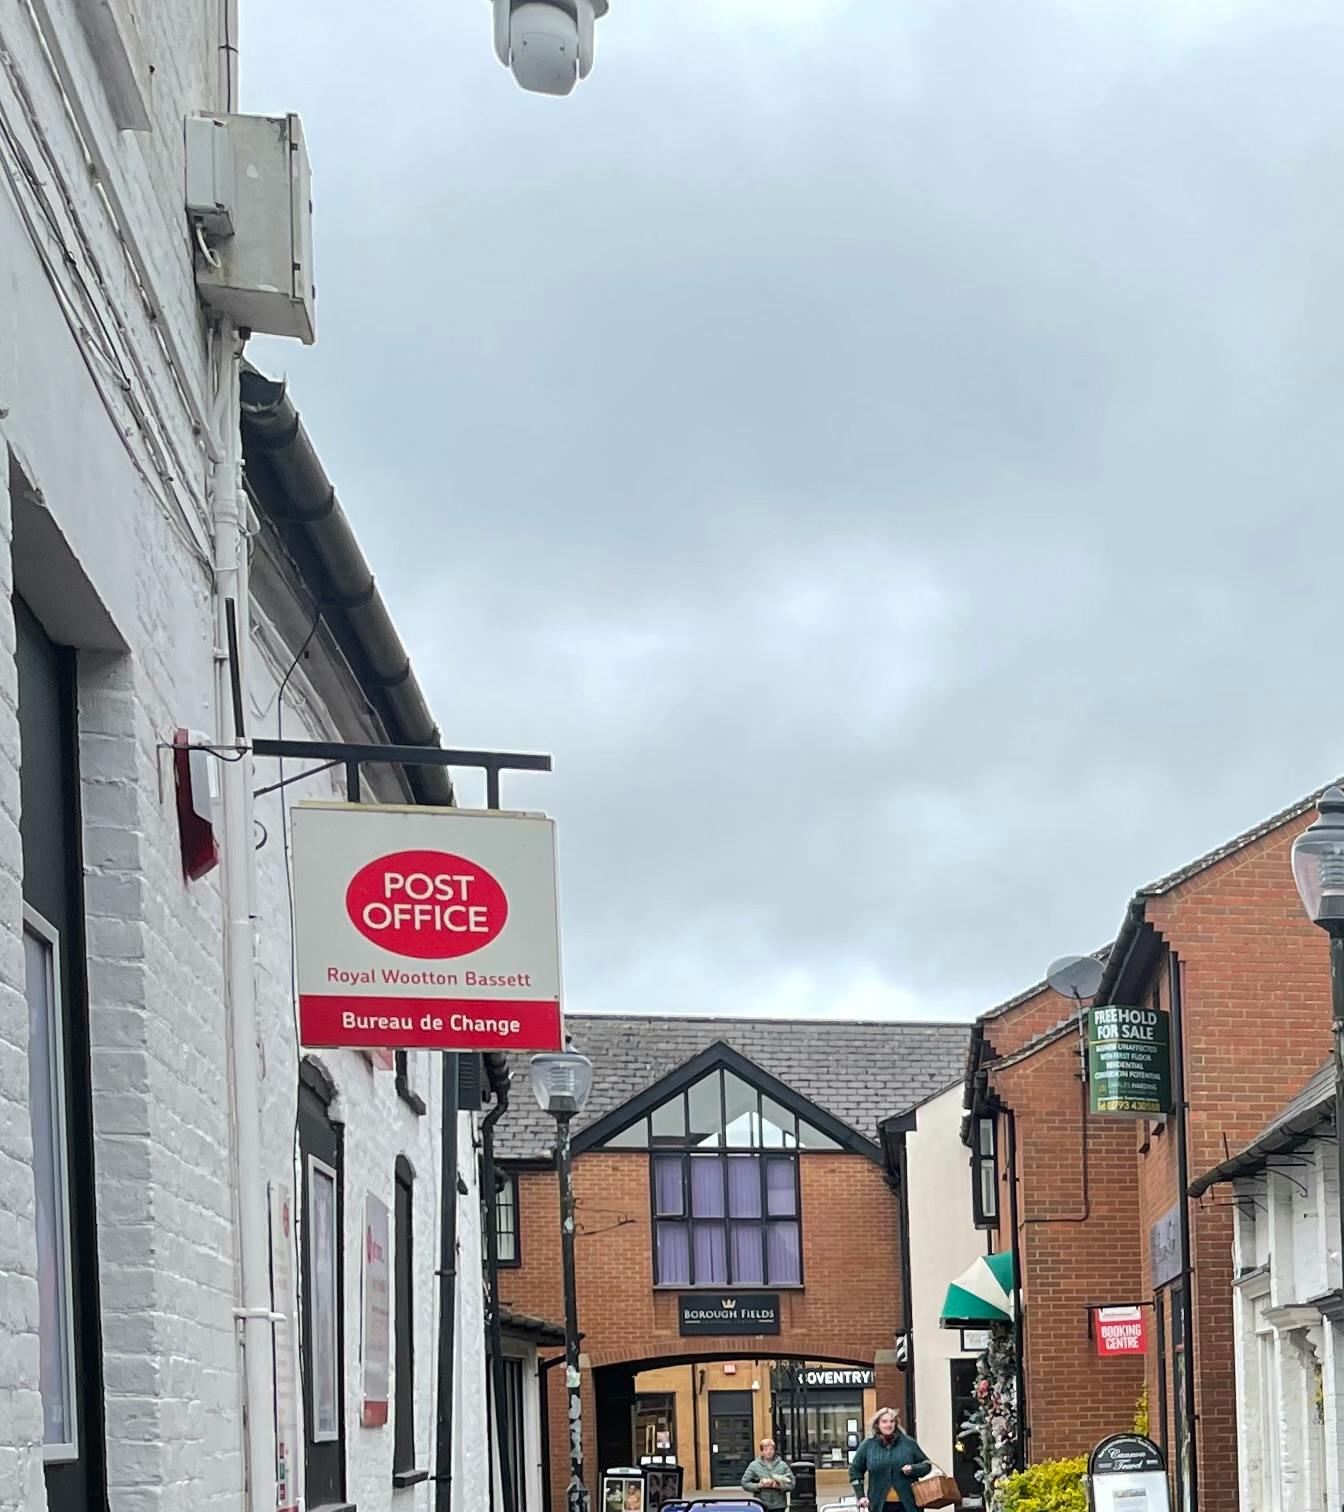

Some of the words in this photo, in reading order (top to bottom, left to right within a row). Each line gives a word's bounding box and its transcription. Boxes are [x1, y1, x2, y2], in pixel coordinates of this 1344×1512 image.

[383, 872, 475, 901] POST
[362, 902, 489, 933] OFFICE
[327, 967, 376, 986] Royal
[381, 969, 458, 985] Wootton
[465, 971, 532, 988] Bassett
[342, 1011, 413, 1030] Bureau
[420, 1013, 443, 1031] de
[450, 1014, 521, 1036] Change
[1094, 1008, 1158, 1025] FREEHOLD
[1097, 1024, 1119, 1040] FOR
[1121, 1024, 1154, 1040] SALE
[684, 1309, 737, 1319] BOROUGH
[741, 1308, 775, 1319] FIELDS
[1101, 1324, 1142, 1338] BOOKING
[1105, 1337, 1139, 1350] CENTRE
